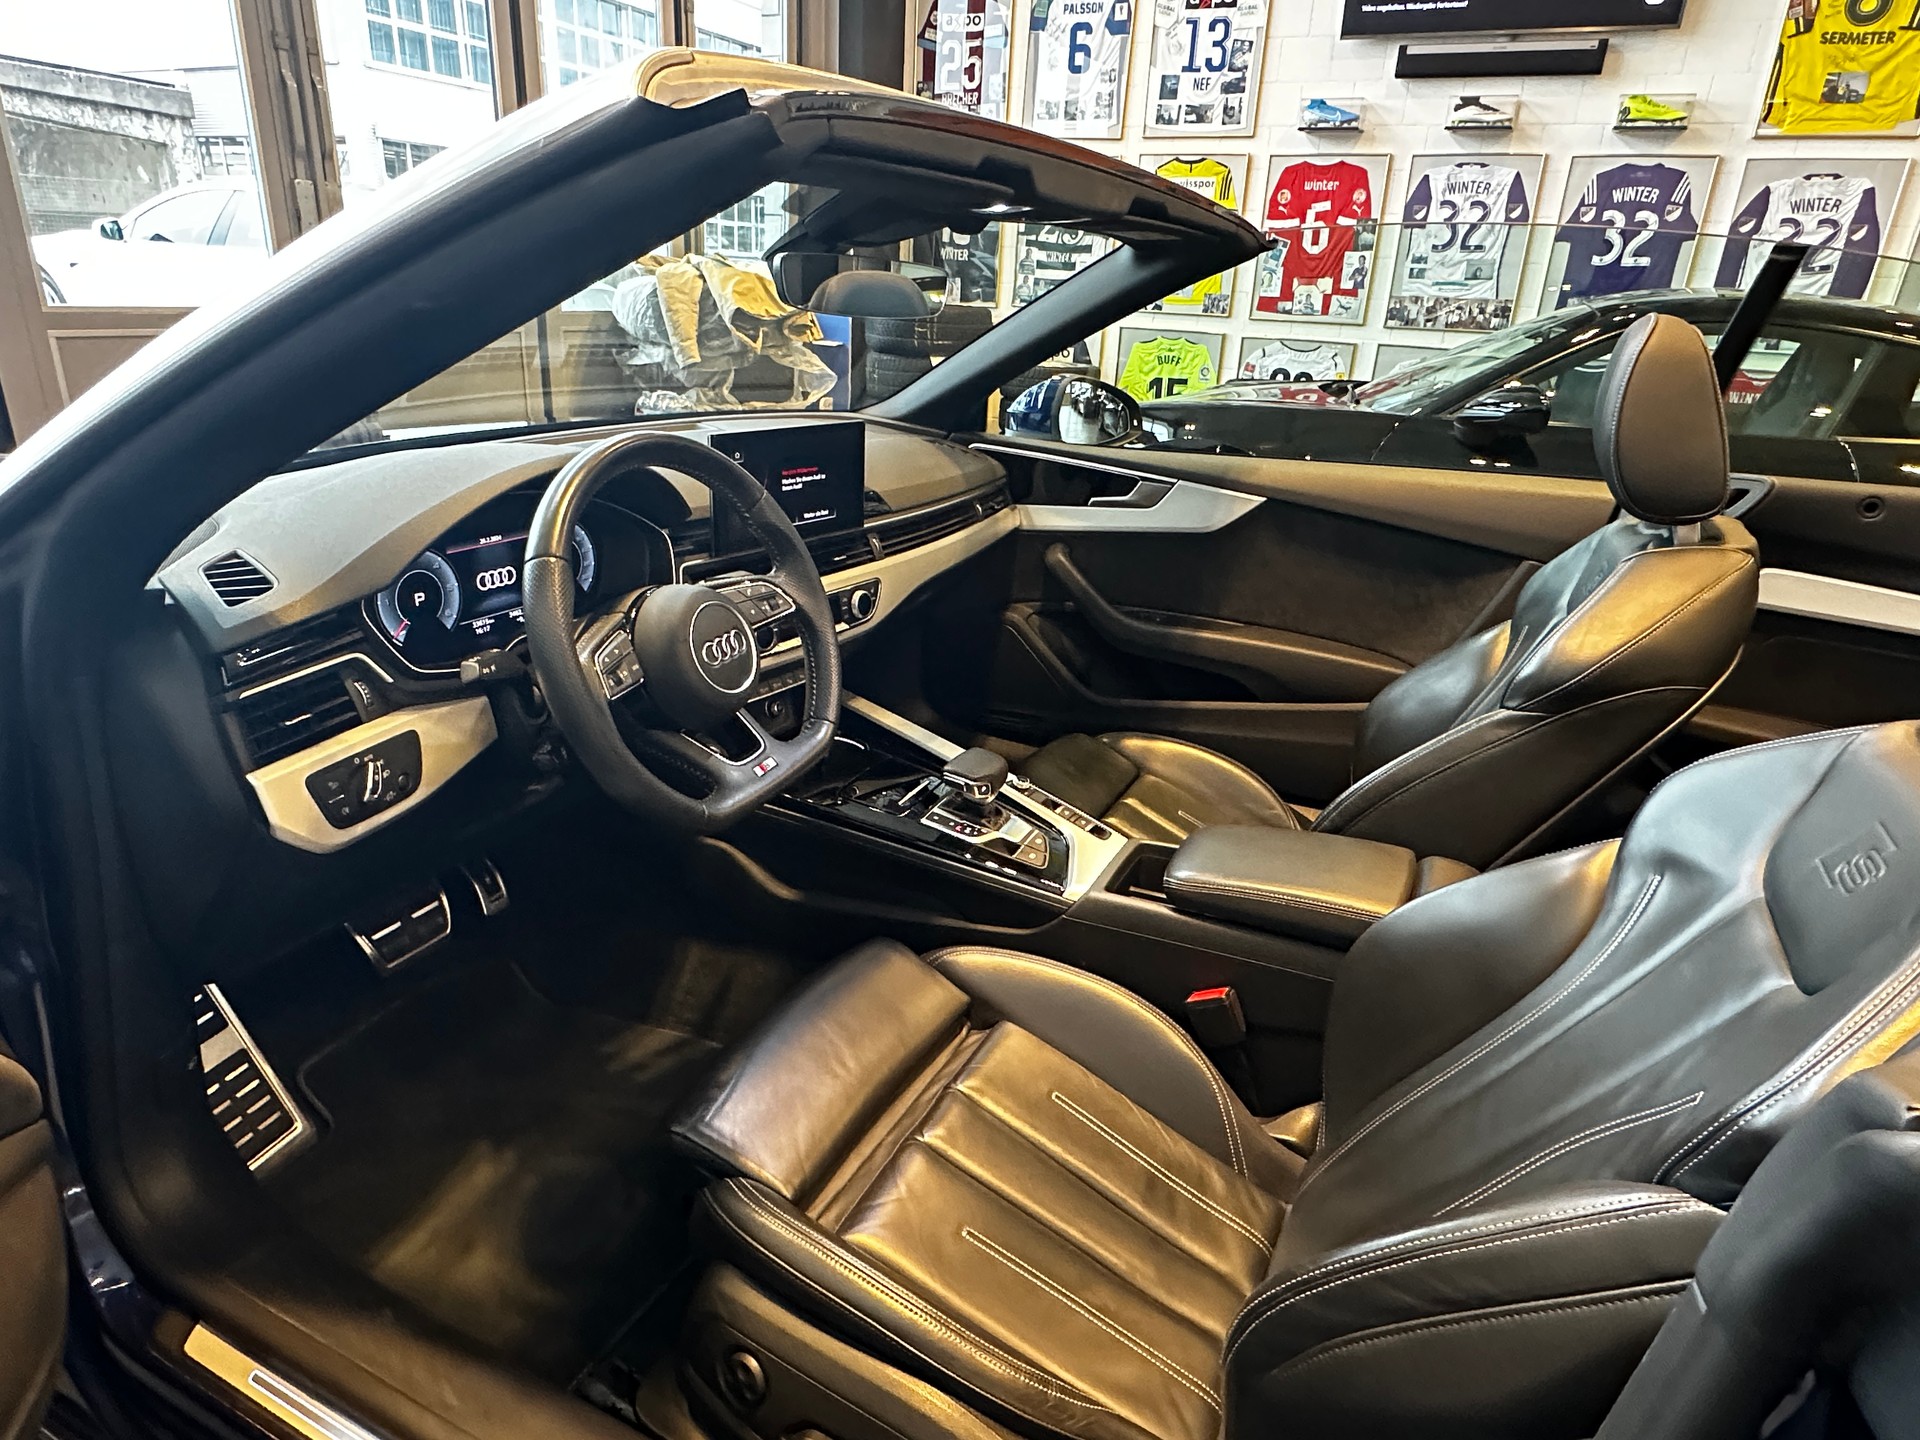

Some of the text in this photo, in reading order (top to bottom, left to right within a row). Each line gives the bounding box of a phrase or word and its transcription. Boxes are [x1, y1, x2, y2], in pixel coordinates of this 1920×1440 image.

[1063, 2, 1104, 14] PALSSON
[1181, 16, 1232, 73] 13
[1820, 30, 1896, 45] SERMETER
[1068, 22, 1093, 74] 6
[940, 38, 982, 91] 25
[1193, 77, 1211, 91] NEF
[1304, 179, 1339, 191] winter
[1447, 181, 1491, 195] WINTER
[1612, 186, 1660, 204] WINTER
[1790, 198, 1842, 215] WINTER
[1301, 200, 1332, 255] 6
[1431, 199, 1491, 254] 32
[1591, 209, 1659, 267] 32
[1157, 355, 1182, 367] BUFF
[414, 592, 426, 607] P
